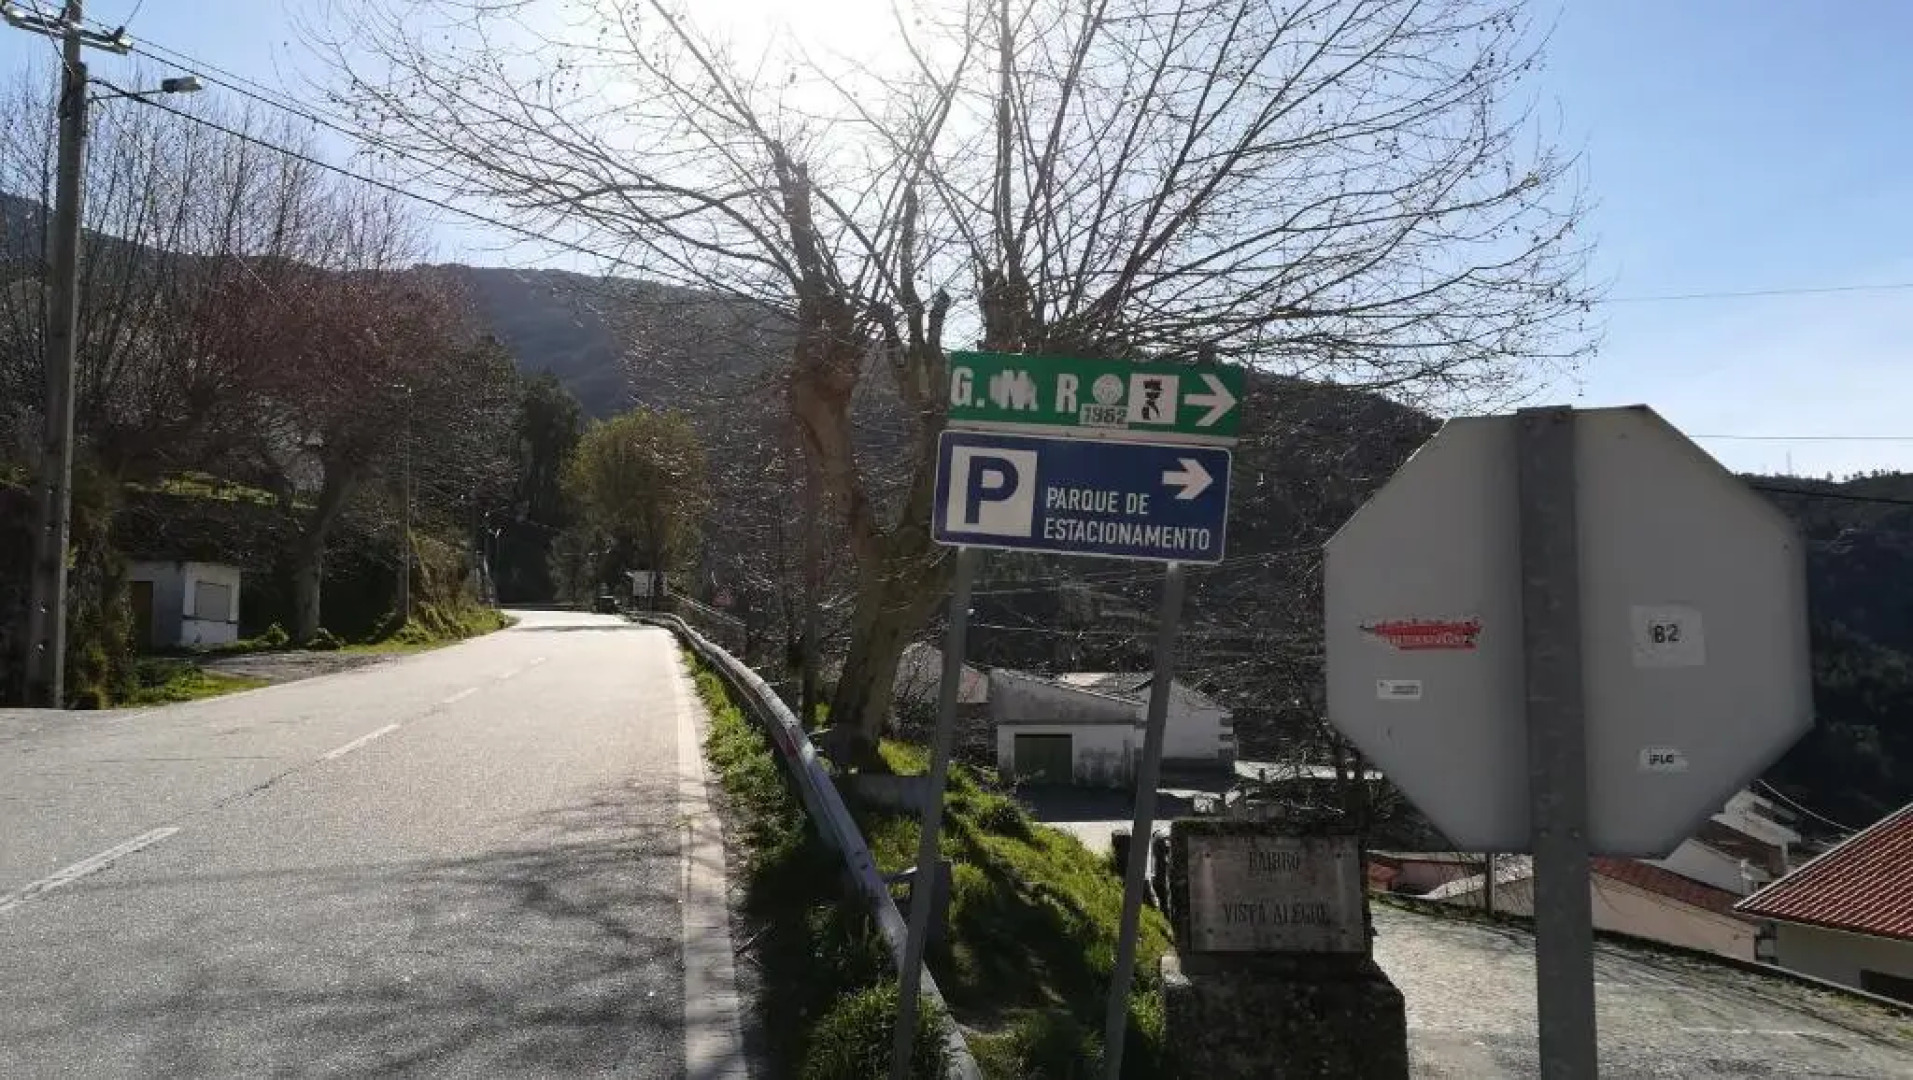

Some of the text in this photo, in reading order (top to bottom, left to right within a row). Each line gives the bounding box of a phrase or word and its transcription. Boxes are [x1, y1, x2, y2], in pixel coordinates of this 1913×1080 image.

[964, 455, 1019, 524] P
[1046, 486, 1150, 515] PARQUE DE
[1044, 517, 1210, 550] ESTACIONAMENTO
